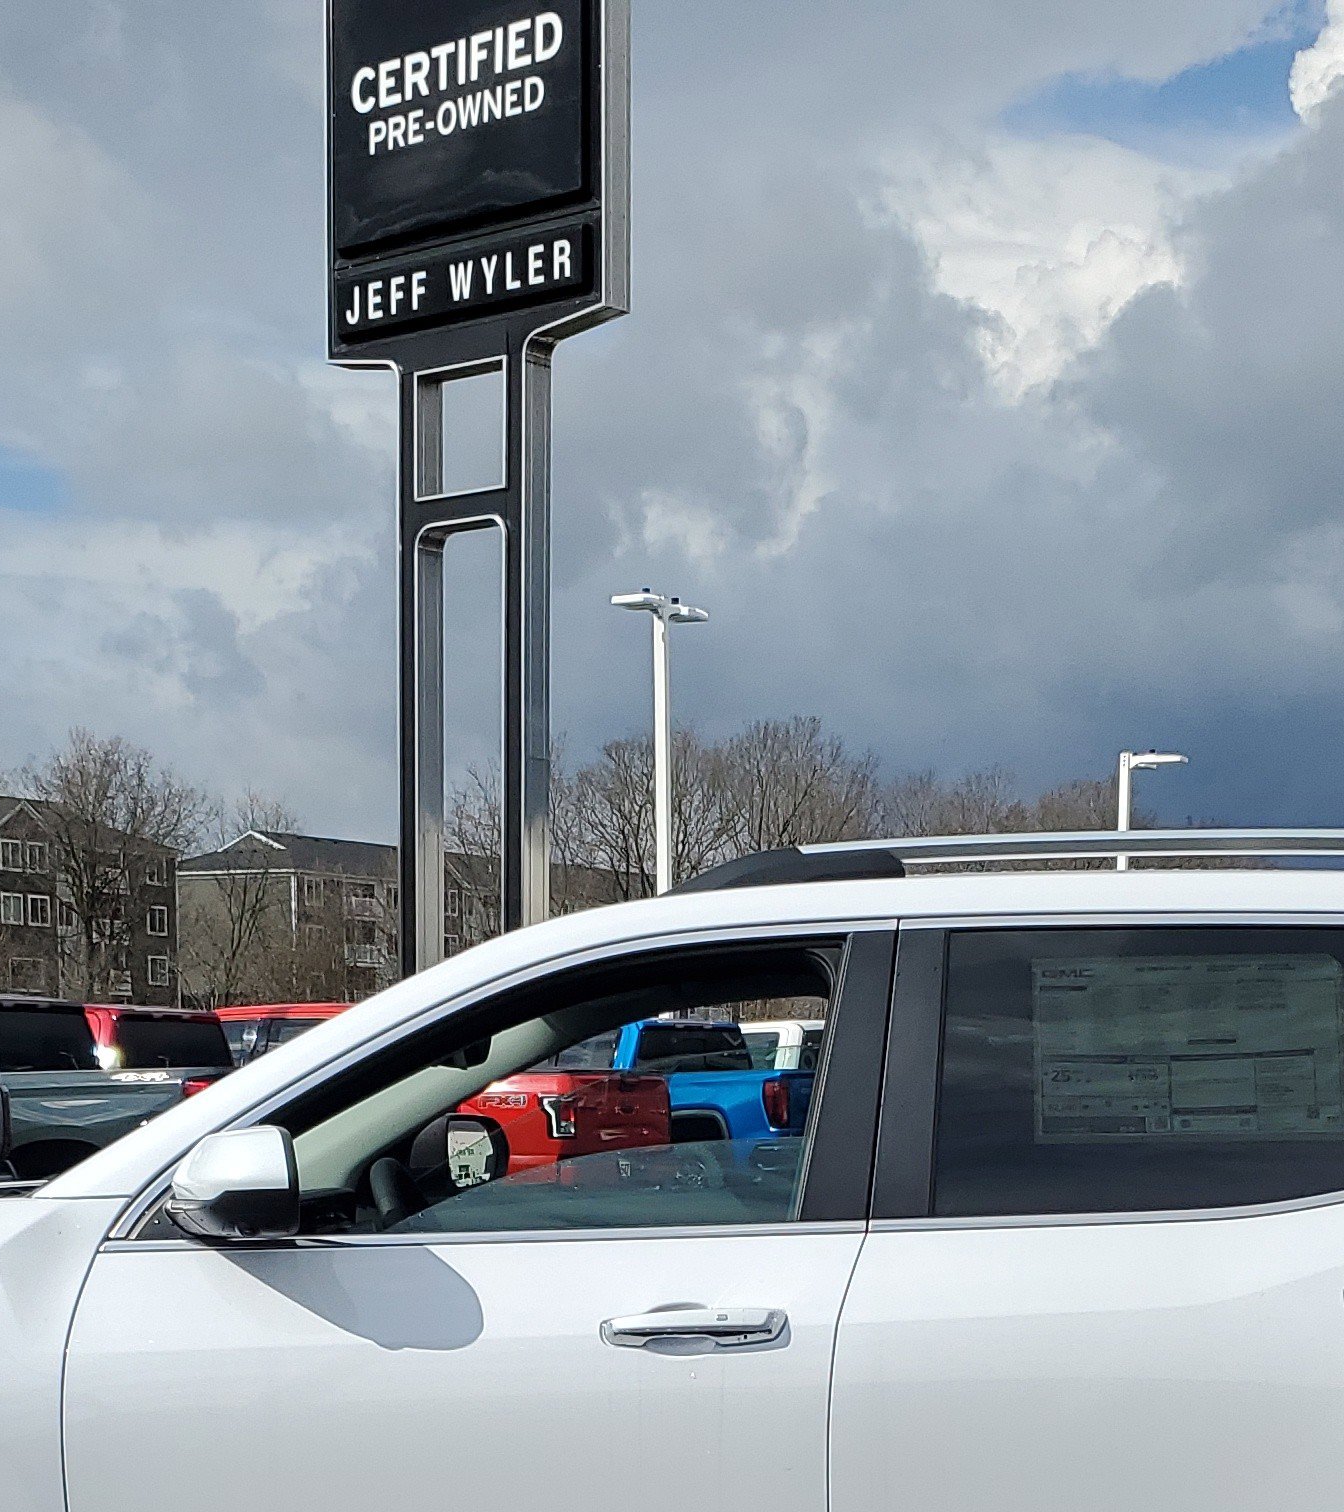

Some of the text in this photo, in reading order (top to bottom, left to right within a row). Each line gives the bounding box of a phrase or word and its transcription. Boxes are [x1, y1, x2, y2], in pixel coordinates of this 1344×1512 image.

[351, 11, 564, 114] CERTIFIED
[368, 75, 545, 156] PRE-OWNED
[345, 239, 572, 326] JEFF WYLER
